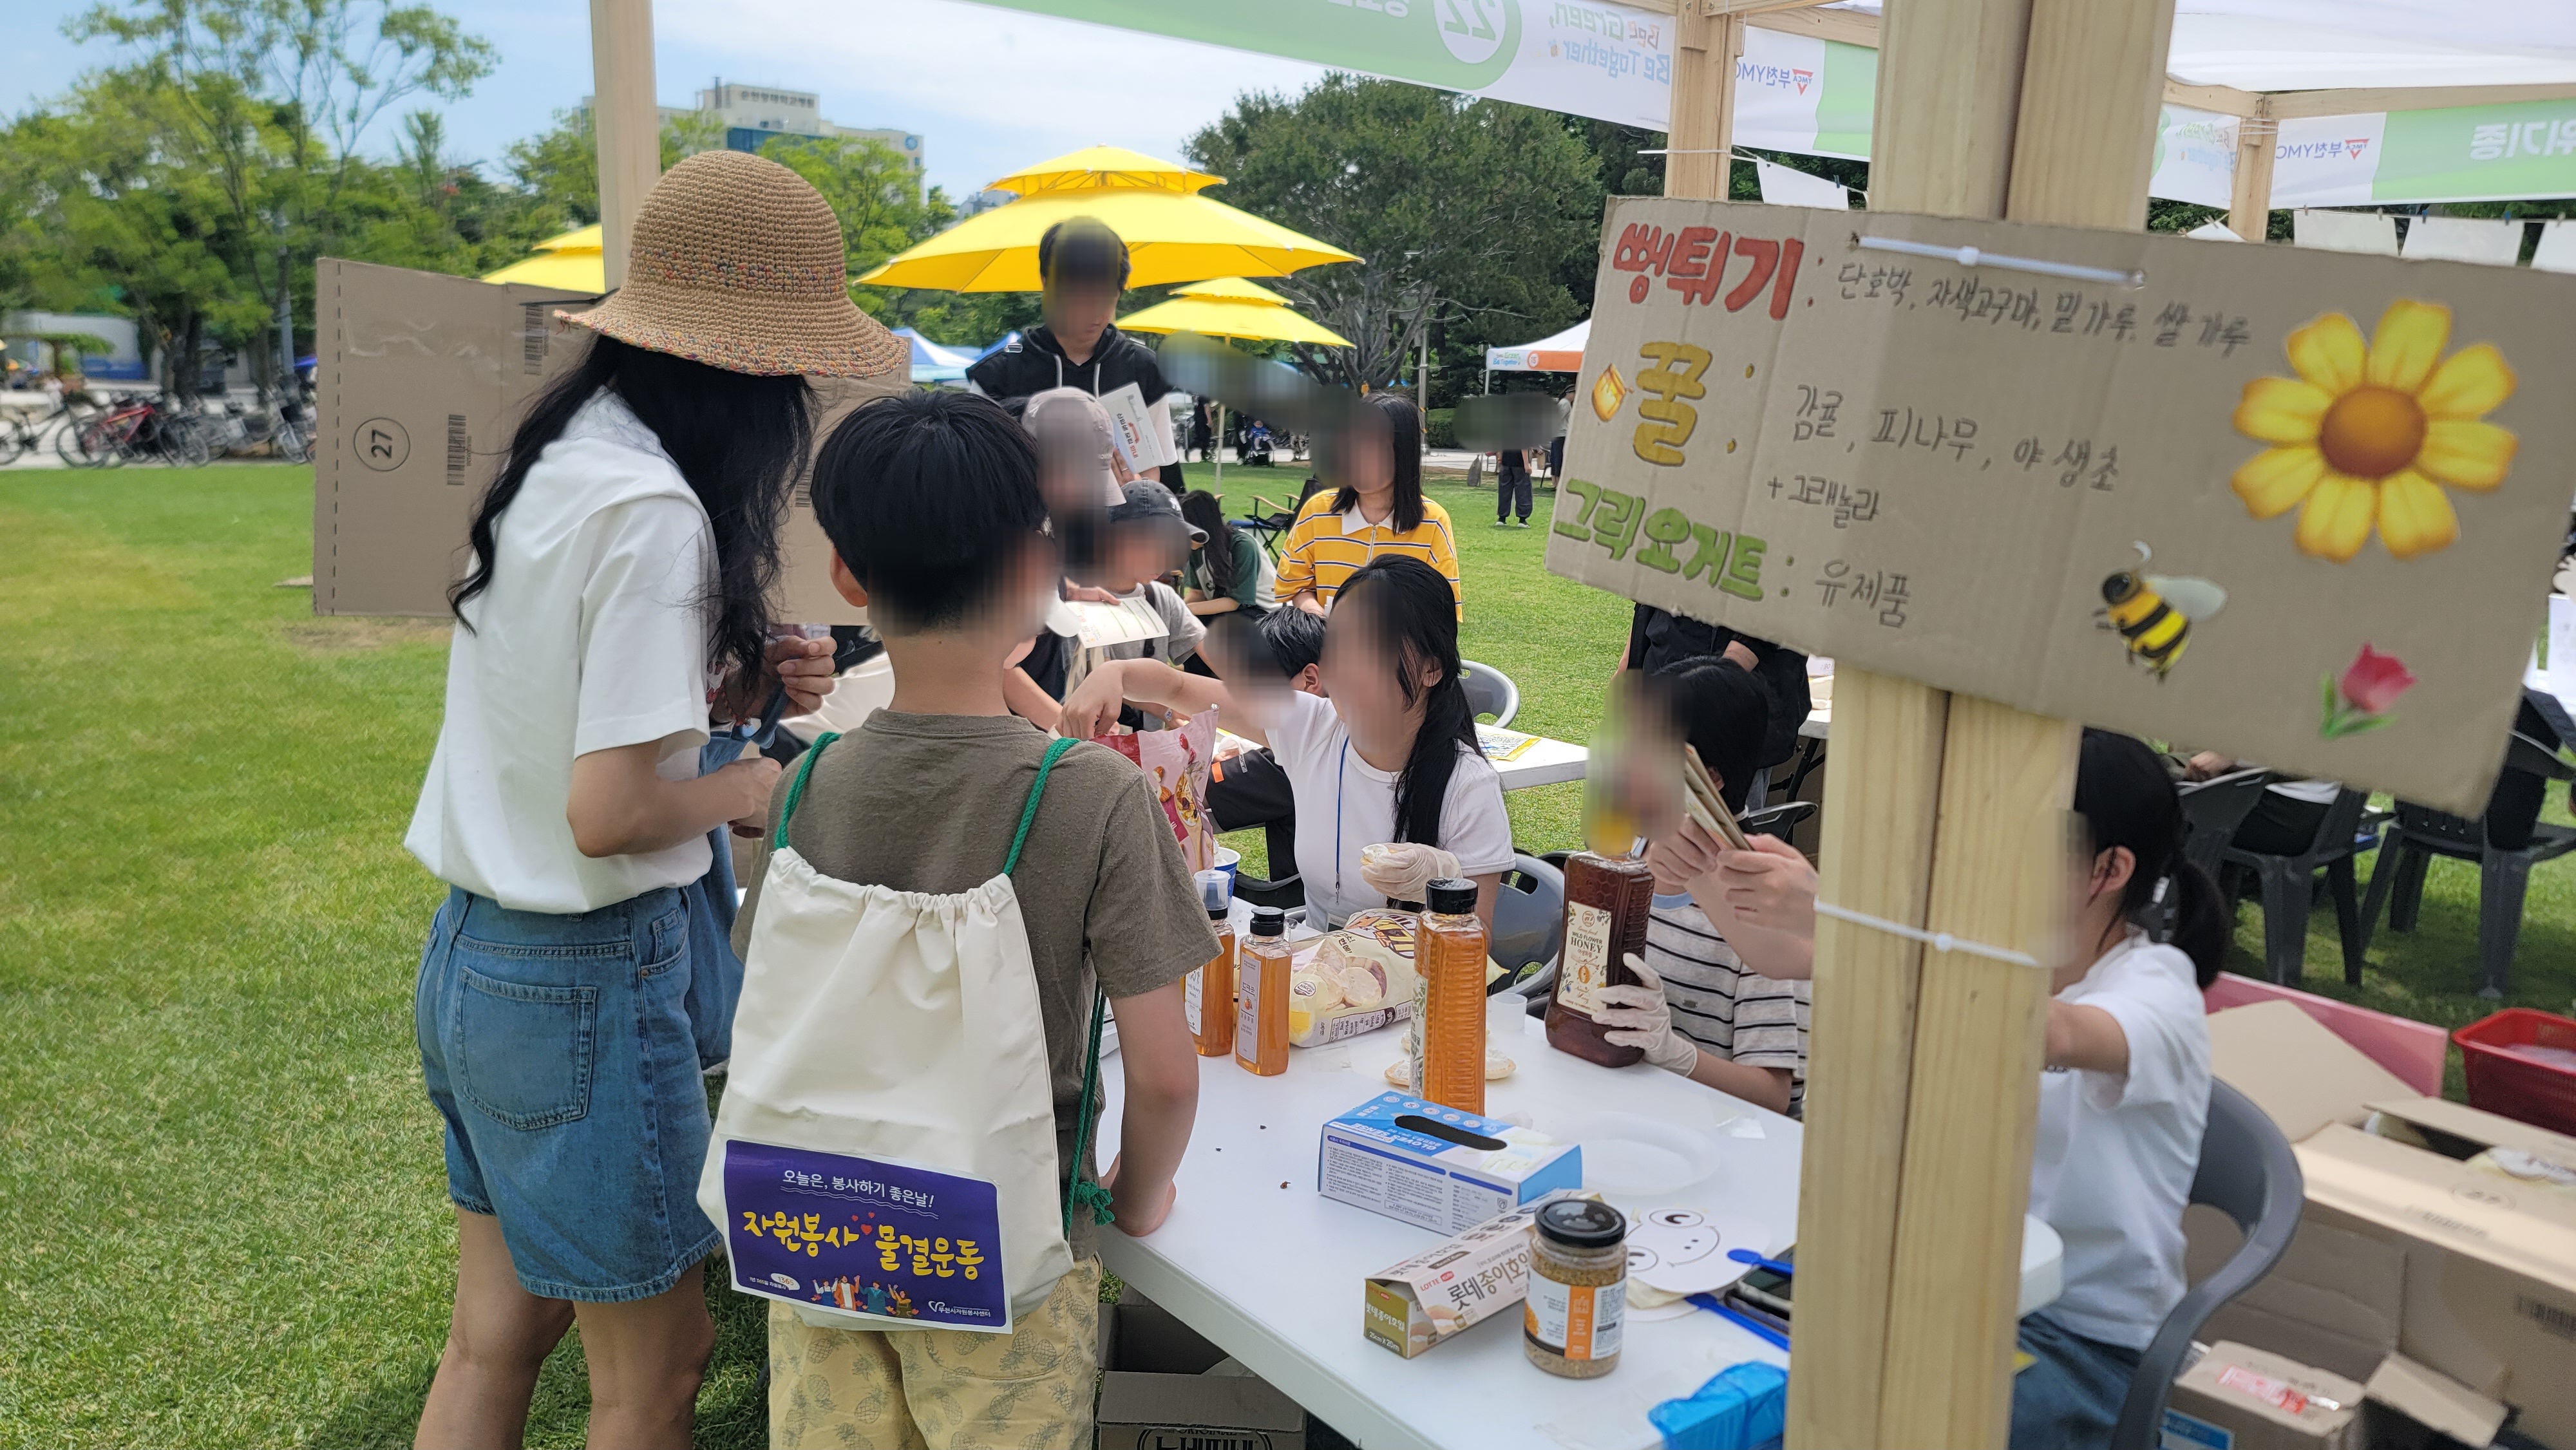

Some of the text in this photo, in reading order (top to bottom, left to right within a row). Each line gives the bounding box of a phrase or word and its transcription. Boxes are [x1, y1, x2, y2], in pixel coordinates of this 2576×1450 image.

[372, 429, 392, 459] 27
[1815, 559, 1910, 628] 유제품
[1570, 937, 1604, 954] HONEY
[1583, 934, 1603, 945] FLOWER
[1351, 1122, 1390, 1138] SENSE
[1391, 1134, 1437, 1151] GLOVES
[782, 1170, 934, 1209] 오늘은, 봉사하기 좋은날!
[743, 1211, 984, 1281] 자원봉사 물결운동
[778, 1276, 794, 1286] 1365
[1420, 1278, 1440, 1291] LOTTE
